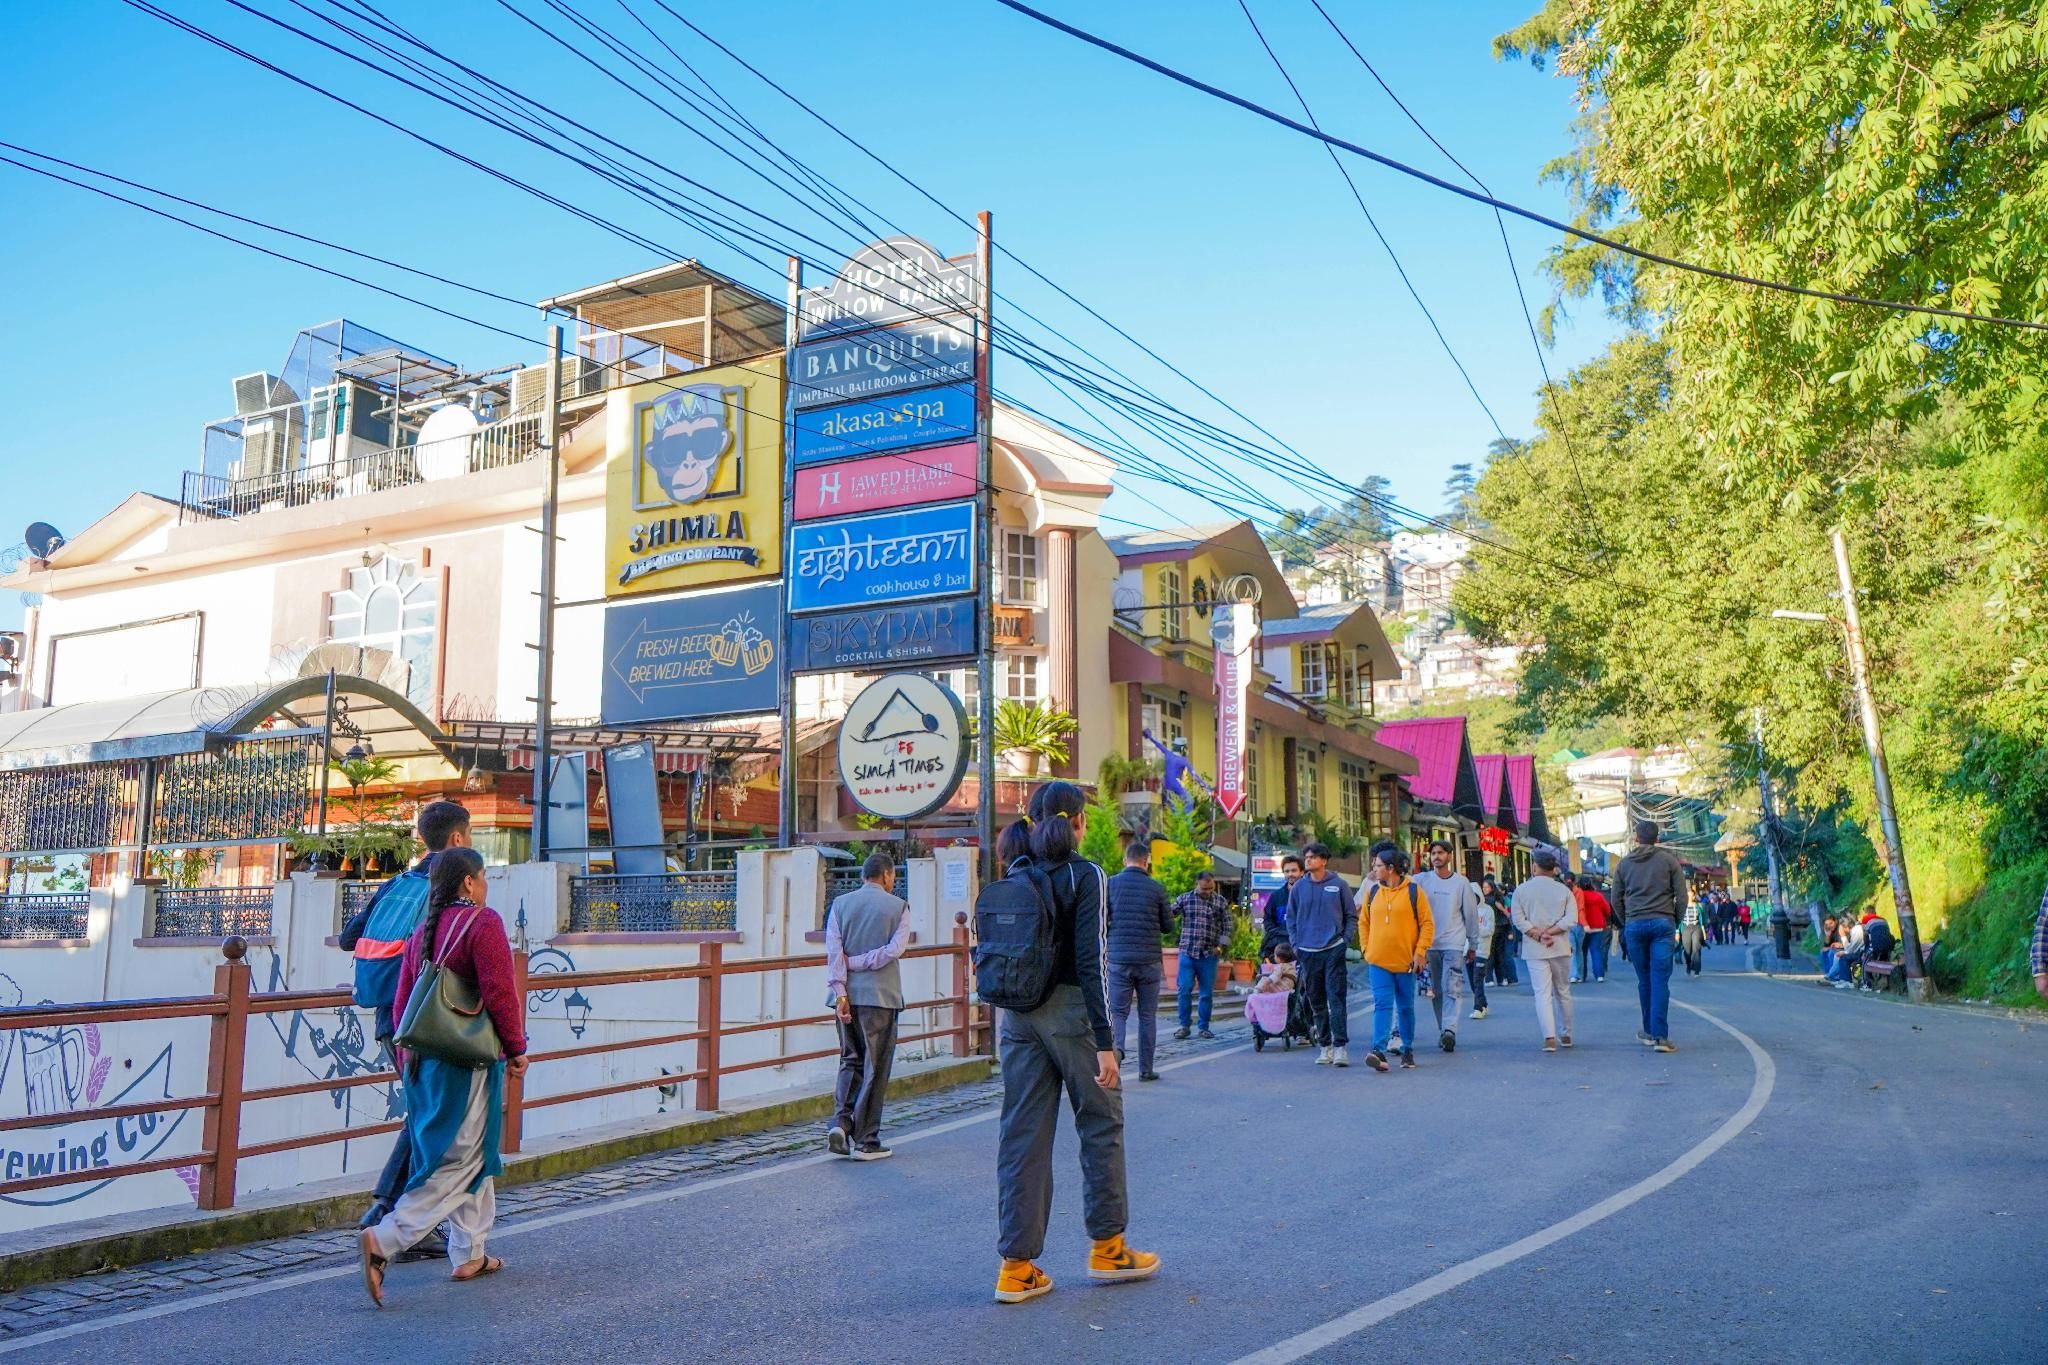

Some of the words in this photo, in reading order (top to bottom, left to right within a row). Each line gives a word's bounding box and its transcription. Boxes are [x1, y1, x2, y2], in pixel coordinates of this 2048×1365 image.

[847, 256, 928, 293] HOTEL
[810, 294, 885, 325] WILLOW
[899, 275, 966, 305] BANKS
[807, 329, 962, 378] BANQUETS
[799, 383, 847, 403] IMPERIAL
[849, 372, 907, 394] BALLROOM
[910, 371, 918, 383] &
[920, 361, 969, 379] TERRACE
[822, 411, 885, 437] akasa
[850, 470, 901, 493] JAWED
[903, 462, 953, 486] HABIB
[629, 510, 747, 553] SHIMLA
[630, 553, 683, 575] BREWING
[686, 547, 744, 561] COMPANY
[866, 578, 930, 596] cookhouse
[946, 574, 966, 587] bar
[810, 606, 954, 651] SKYBAR
[636, 637, 679, 659] FRESH
[680, 635, 713, 653] BEER
[835, 649, 884, 663] COCKTAIL
[886, 649, 893, 658] &
[895, 645, 933, 657] SHISHA
[629, 661, 682, 684] BREWED
[682, 659, 715, 677] HERE
[1226, 660, 1239, 699] CLUB
[1226, 706, 1238, 715] &
[854, 759, 897, 781] SIMLA
[899, 756, 945, 776] TIMES
[1223, 720, 1238, 790] BREWERY
[116, 1112, 165, 1152] Co.
